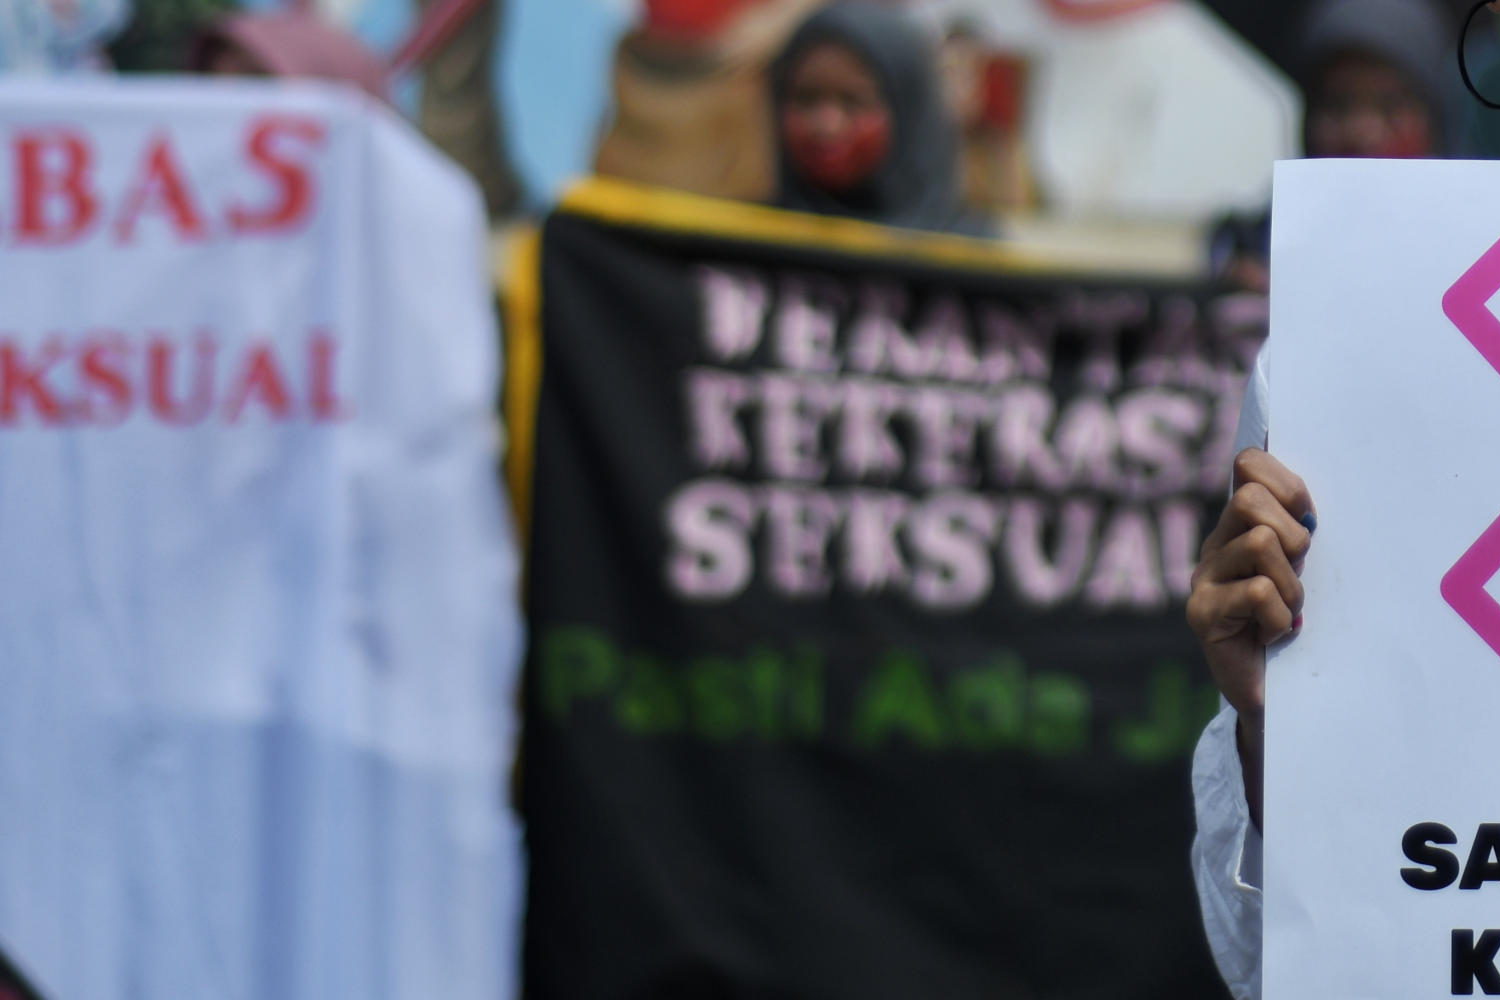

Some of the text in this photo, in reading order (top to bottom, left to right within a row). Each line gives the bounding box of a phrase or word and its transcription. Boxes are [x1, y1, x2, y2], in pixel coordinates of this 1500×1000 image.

[0, 112, 328, 246] BAS
[667, 480, 1198, 612] SEKSUAL
[854, 650, 1092, 754] Ada
